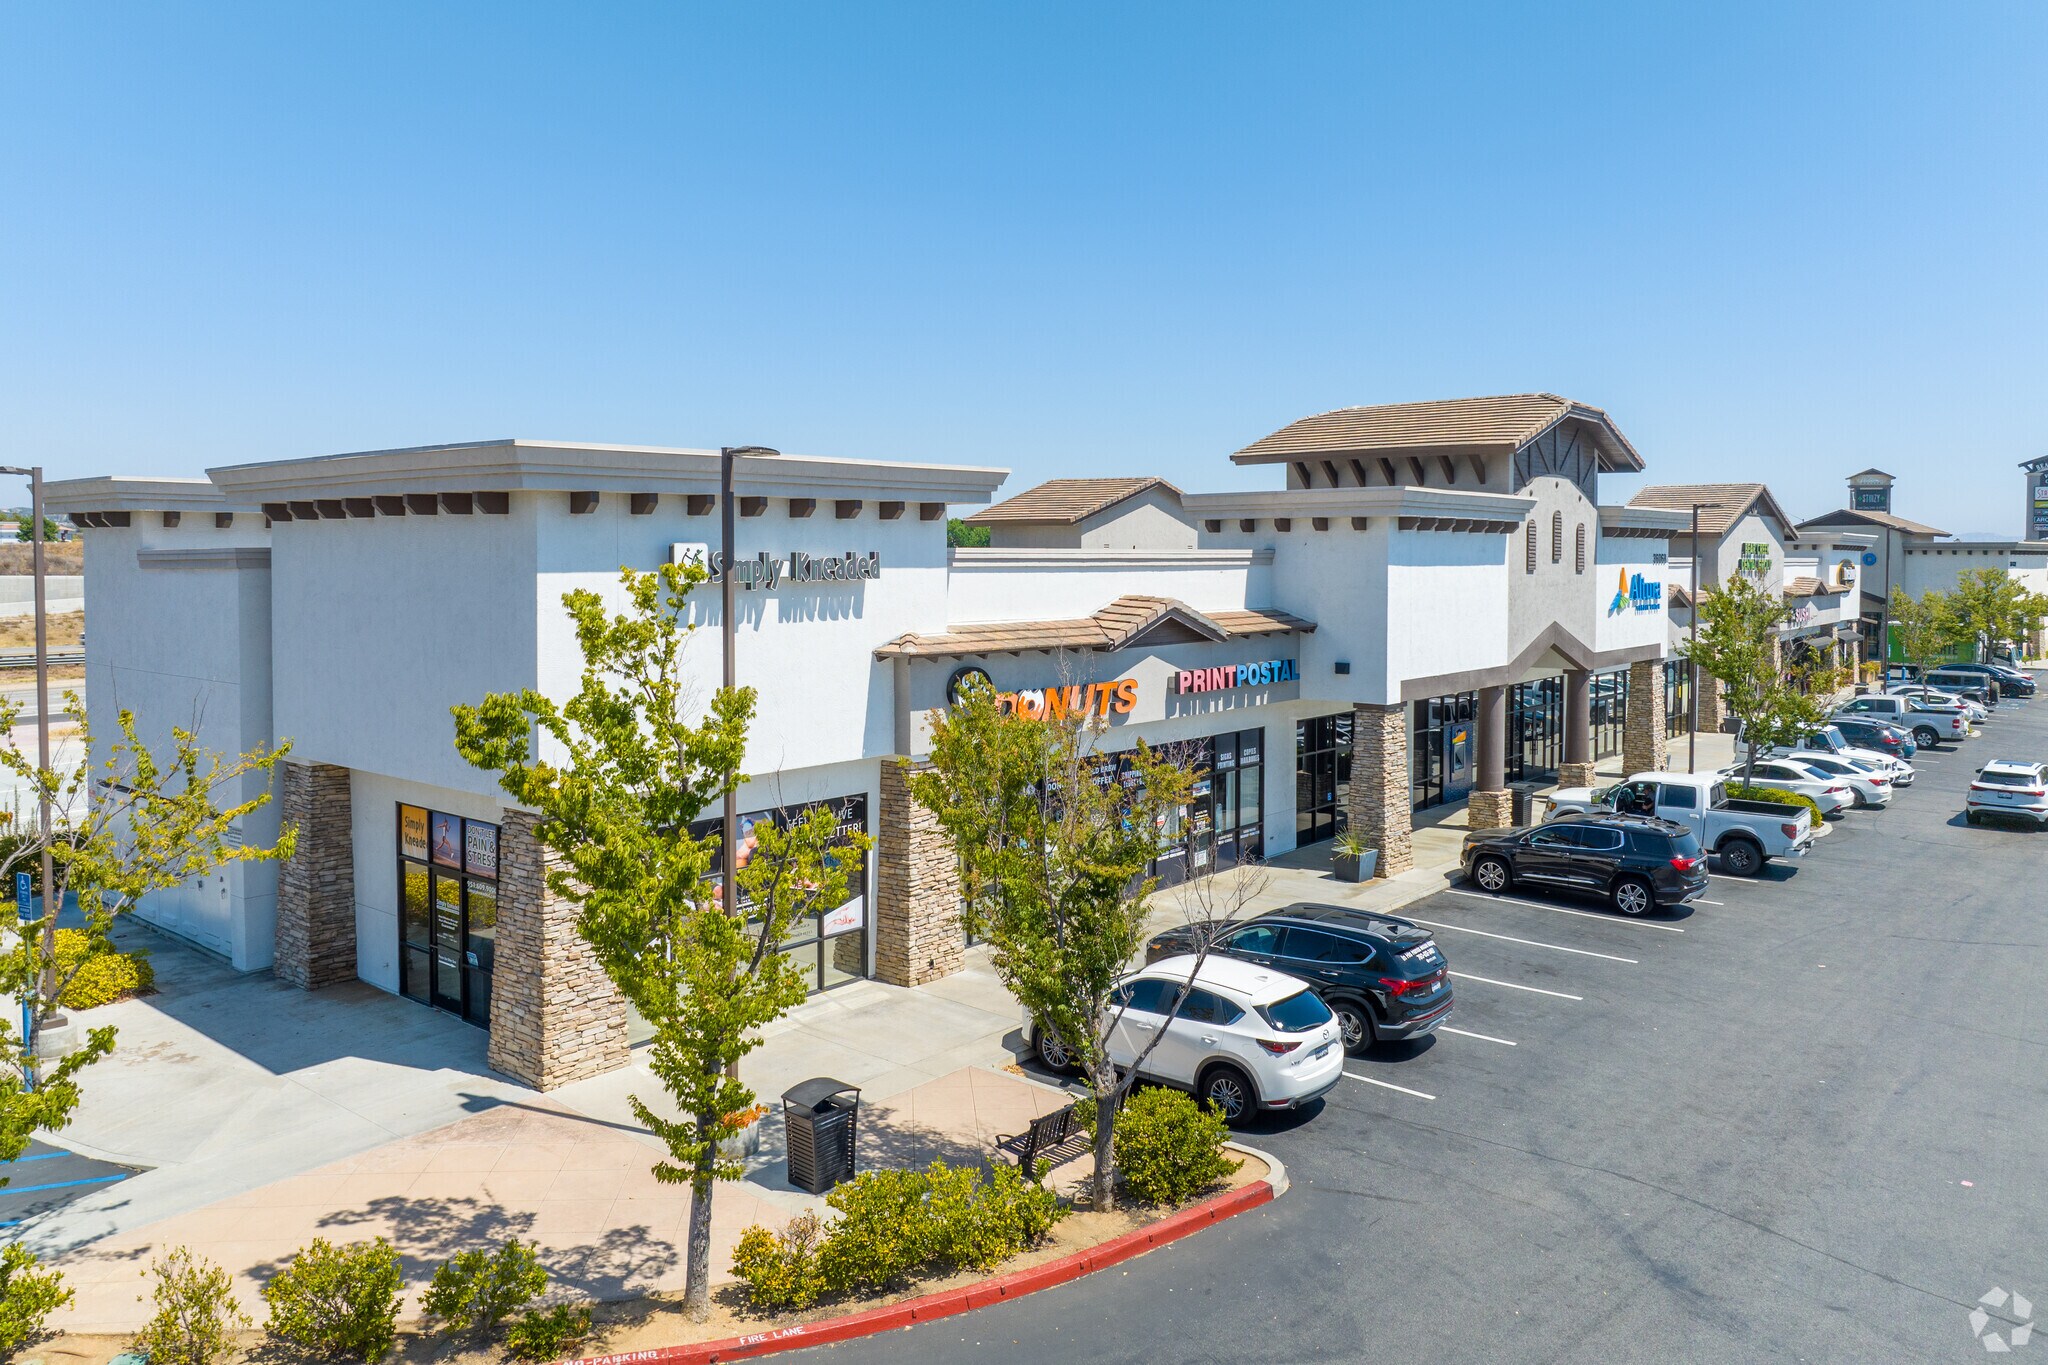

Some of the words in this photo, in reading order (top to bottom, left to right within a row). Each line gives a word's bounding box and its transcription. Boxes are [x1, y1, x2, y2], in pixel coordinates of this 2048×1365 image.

[709, 551, 784, 591] Smply
[791, 551, 881, 582] Kneaded
[1629, 573, 1661, 601] Altura
[995, 678, 1138, 723] DONUTS
[404, 816, 425, 835] Simply
[467, 835, 487, 852] PAIN
[489, 840, 496, 854] &
[467, 850, 497, 869] STRESS
[740, 1333, 768, 1346] FIRE
[774, 1326, 805, 1340] LANE
